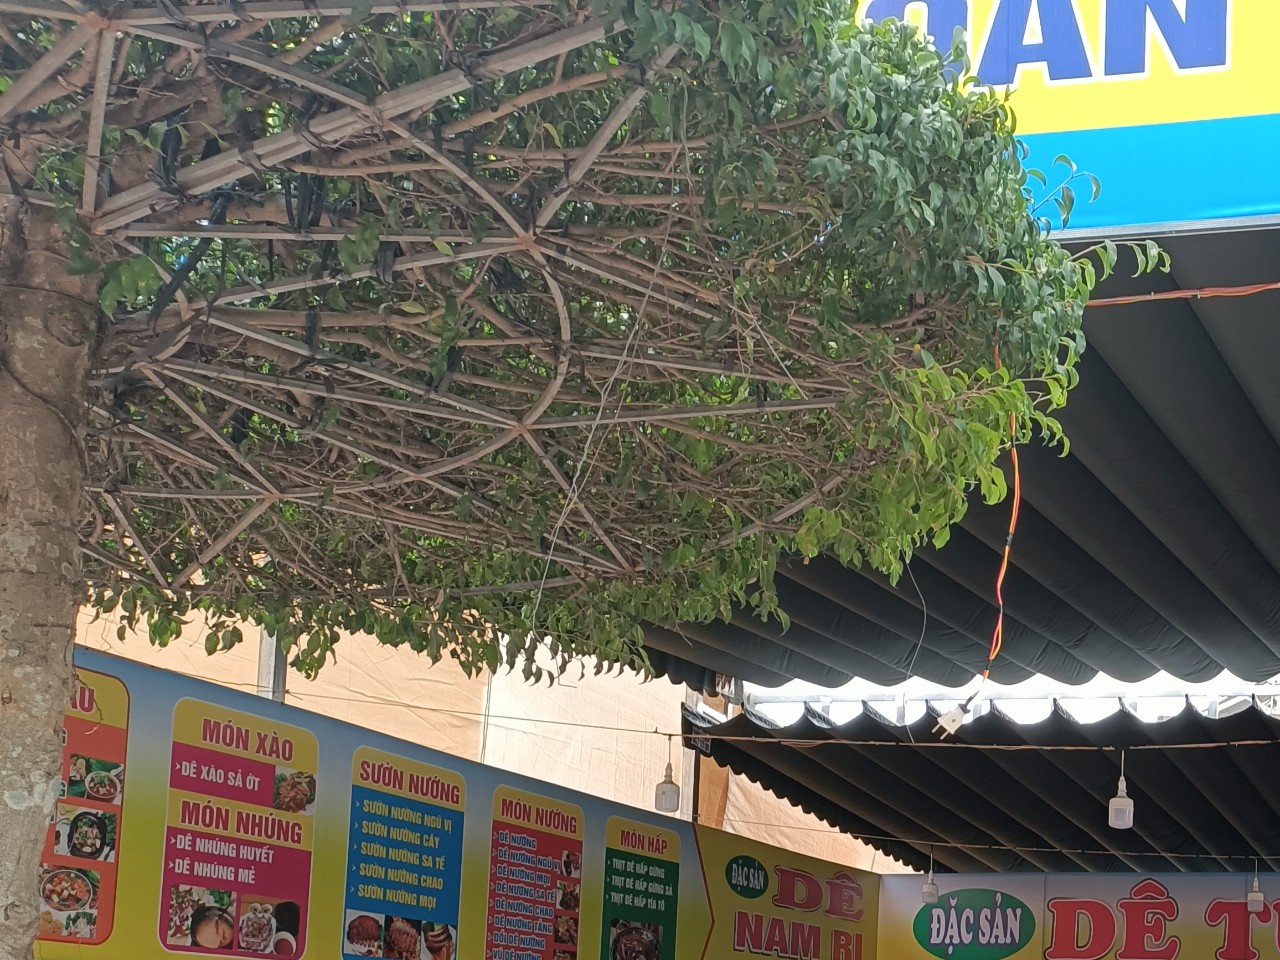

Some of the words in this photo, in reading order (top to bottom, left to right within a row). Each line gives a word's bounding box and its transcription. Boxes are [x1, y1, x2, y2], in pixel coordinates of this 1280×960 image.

[202, 717, 250, 751] MÓN
[255, 731, 294, 762] XÀO
[181, 760, 197, 778] DÊ
[200, 765, 224, 783] XÀO
[227, 769, 243, 788] SẢ
[246, 775, 260, 791] ỚT
[360, 760, 404, 790] SƯỜN
[408, 773, 460, 806] NƯỚNG
[181, 799, 230, 831] MÓN
[236, 810, 303, 845] NHÚNG
[502, 798, 531, 823] MÓN
[535, 807, 577, 834] NƯỚNG
[176, 833, 192, 851] DÊ
[196, 838, 236, 858] NHÚNG
[240, 845, 274, 864] HUYẾT
[498, 830, 509, 843] DÊ
[620, 829, 645, 850] MÓN
[647, 833, 668, 855] HẤP
[174, 858, 191, 875] DÊ
[194, 861, 235, 881] NHÚNG
[421, 875, 443, 890] CHAO
[731, 860, 748, 891] ĐẶC
[749, 862, 765, 893] SẢN
[772, 865, 864, 922] DÊ
[930, 896, 974, 955] ĐẶC
[979, 892, 1022, 944] SẢN
